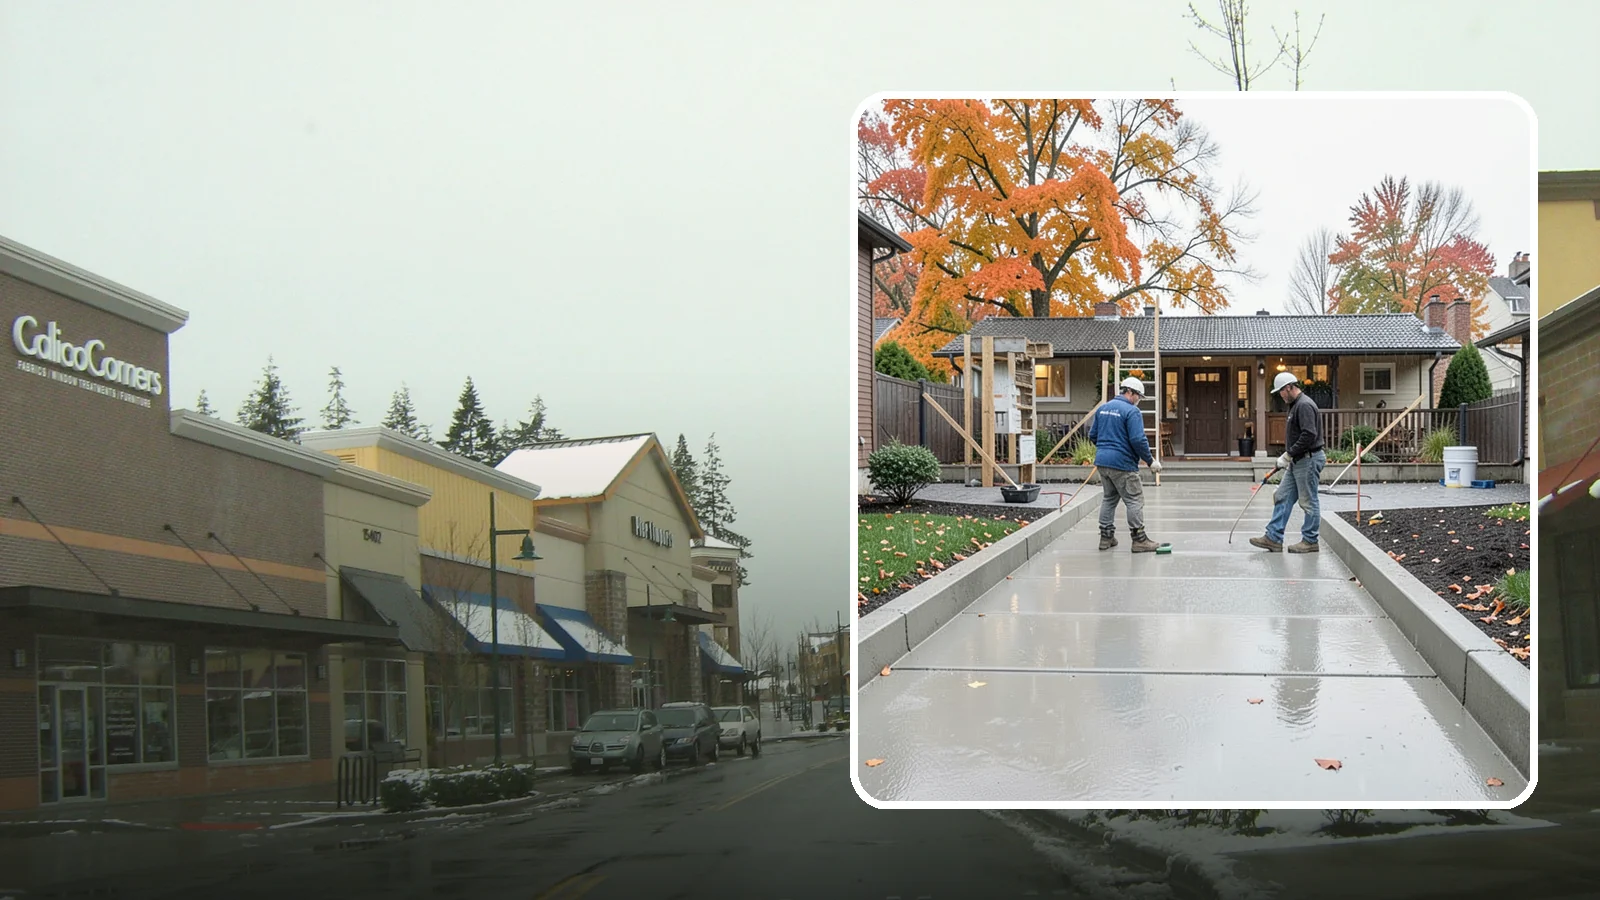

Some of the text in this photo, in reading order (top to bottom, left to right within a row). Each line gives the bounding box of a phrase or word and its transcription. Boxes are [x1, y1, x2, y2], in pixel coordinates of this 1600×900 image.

[16, 359, 151, 408] FABRICS WINDOW TREATMENTS FURNITURE
